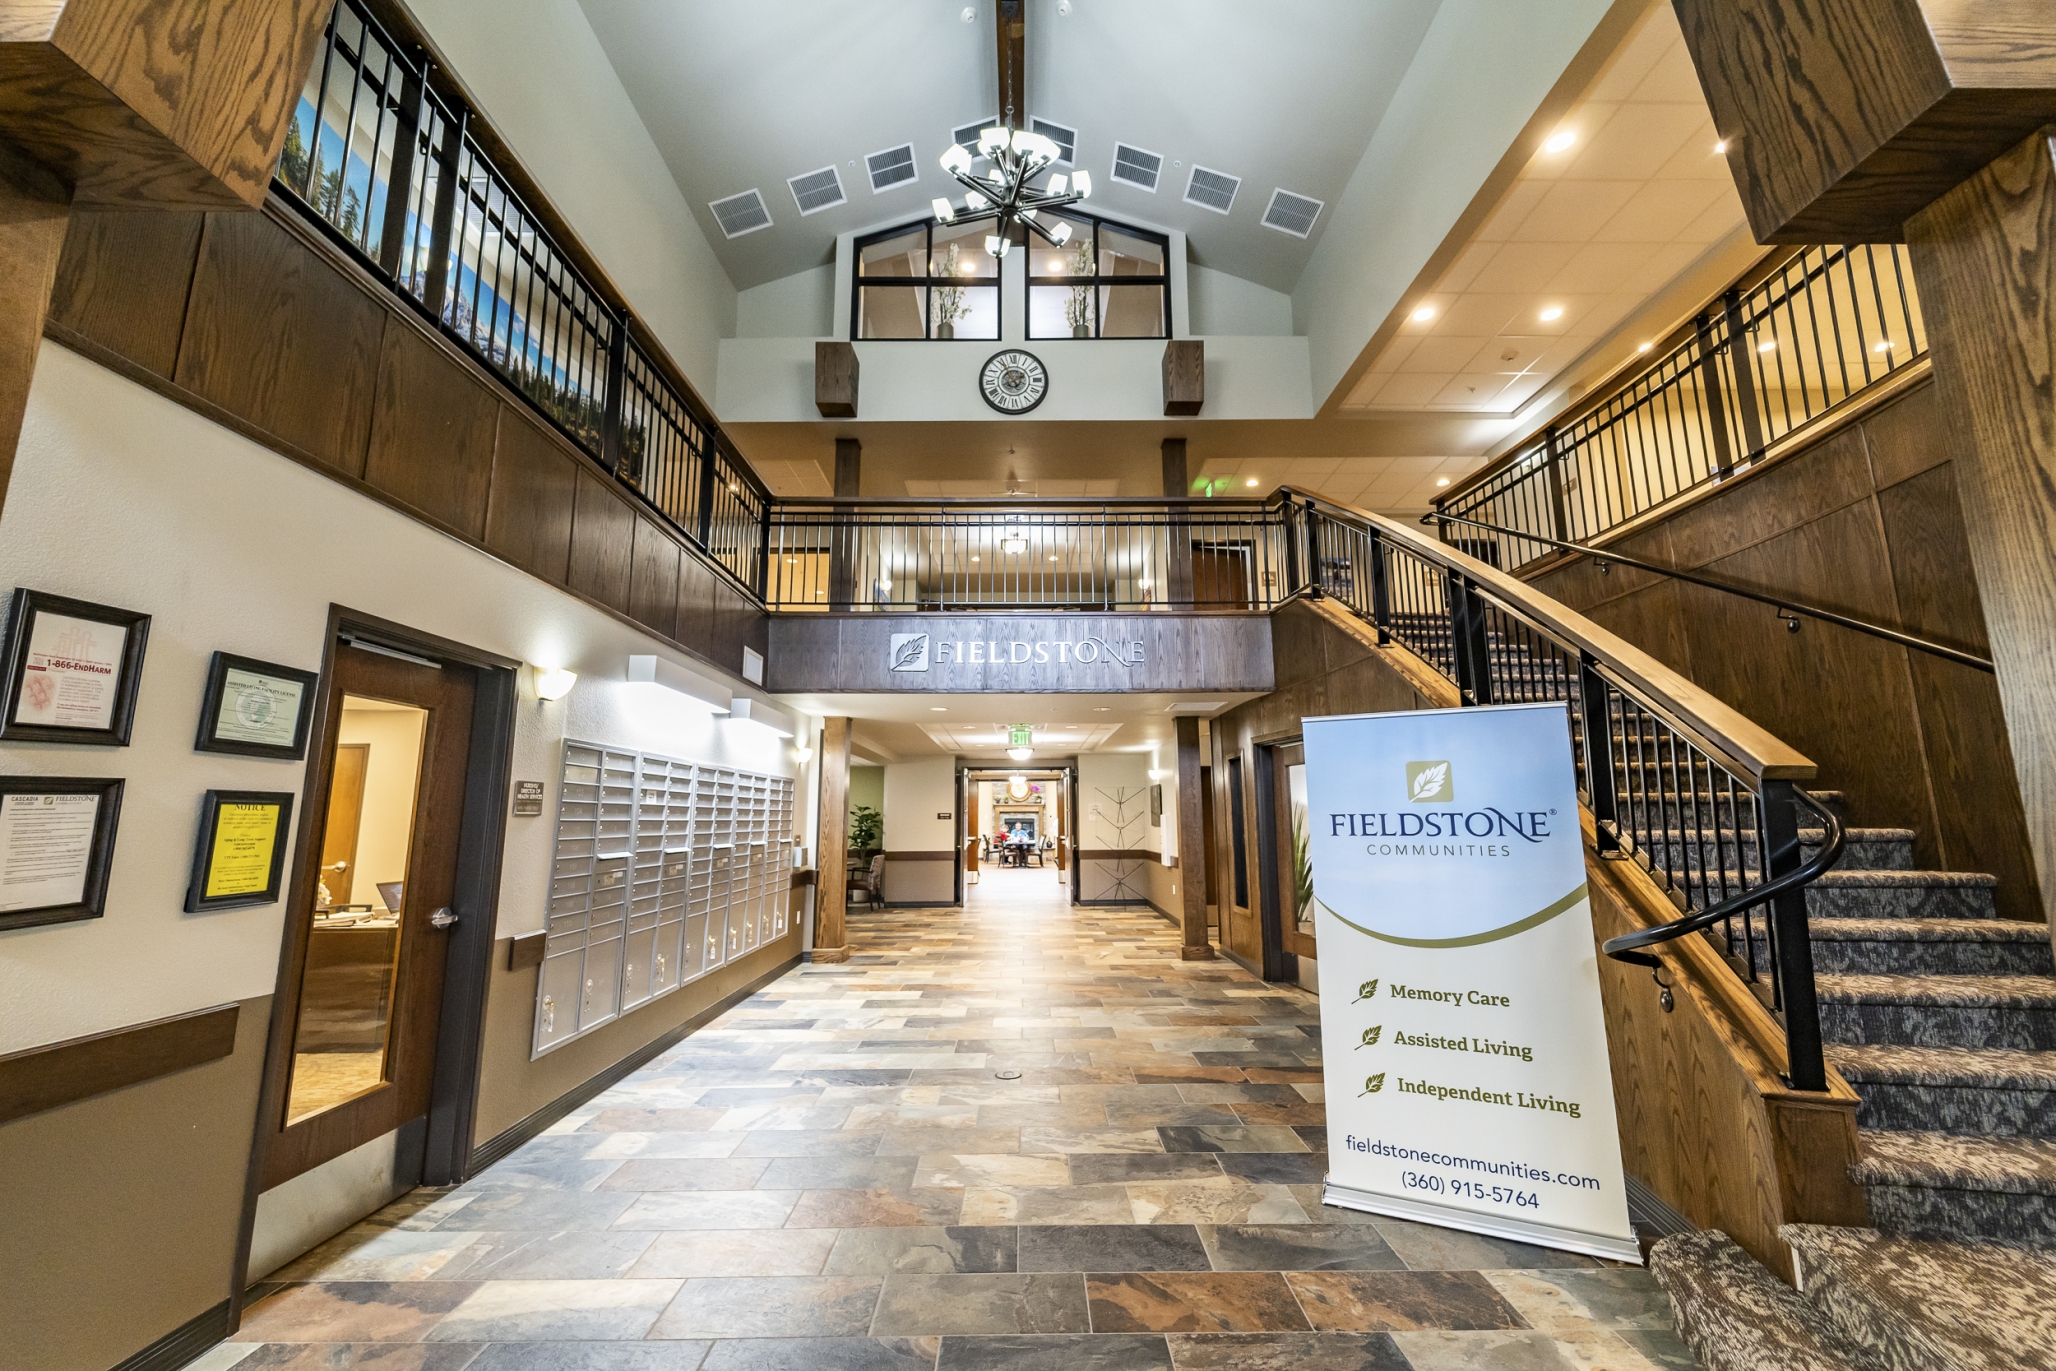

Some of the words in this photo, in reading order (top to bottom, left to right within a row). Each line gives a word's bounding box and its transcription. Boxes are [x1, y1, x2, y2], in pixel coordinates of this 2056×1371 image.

[935, 636, 1145, 668] FIELDSTONE
[1012, 731, 1030, 746] EXIT
[1366, 844, 1511, 857] COMMUNITIES
[1390, 984, 1463, 1007] Memory
[1467, 990, 1510, 1007] Care
[1394, 1031, 1469, 1051] Assisted
[1472, 1037, 1533, 1062] Living
[1397, 1077, 1514, 1106] Independent
[1517, 1092, 1582, 1119] Living
[1346, 1134, 1600, 1191] fieldstonecommunities.com
[1401, 1171, 1445, 1195] (360)
[1451, 1180, 1540, 1209] 915-5764
